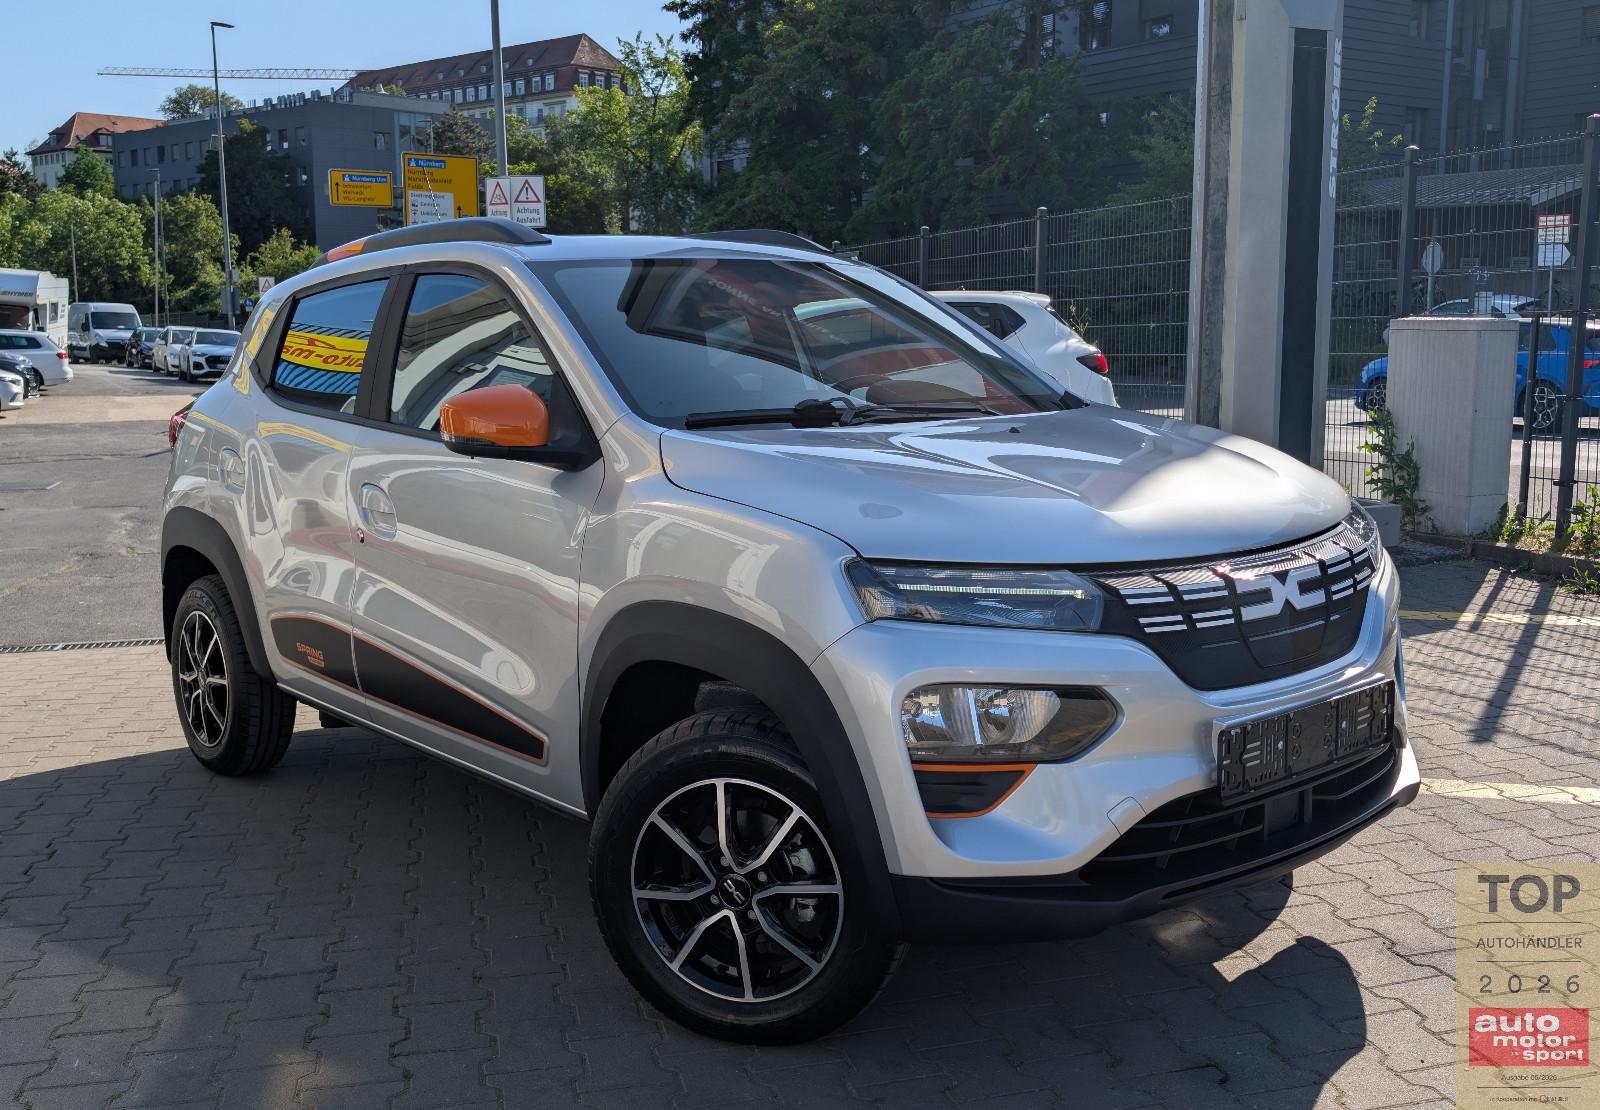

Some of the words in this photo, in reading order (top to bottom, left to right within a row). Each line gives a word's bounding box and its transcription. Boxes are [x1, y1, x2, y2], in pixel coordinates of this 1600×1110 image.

[1329, 37, 1342, 198] STRÖER
[418, 159, 445, 168] Nürnberg
[351, 175, 376, 183] Nürnberg
[517, 206, 540, 215] Achtung
[296, 641, 324, 660] SPRING
